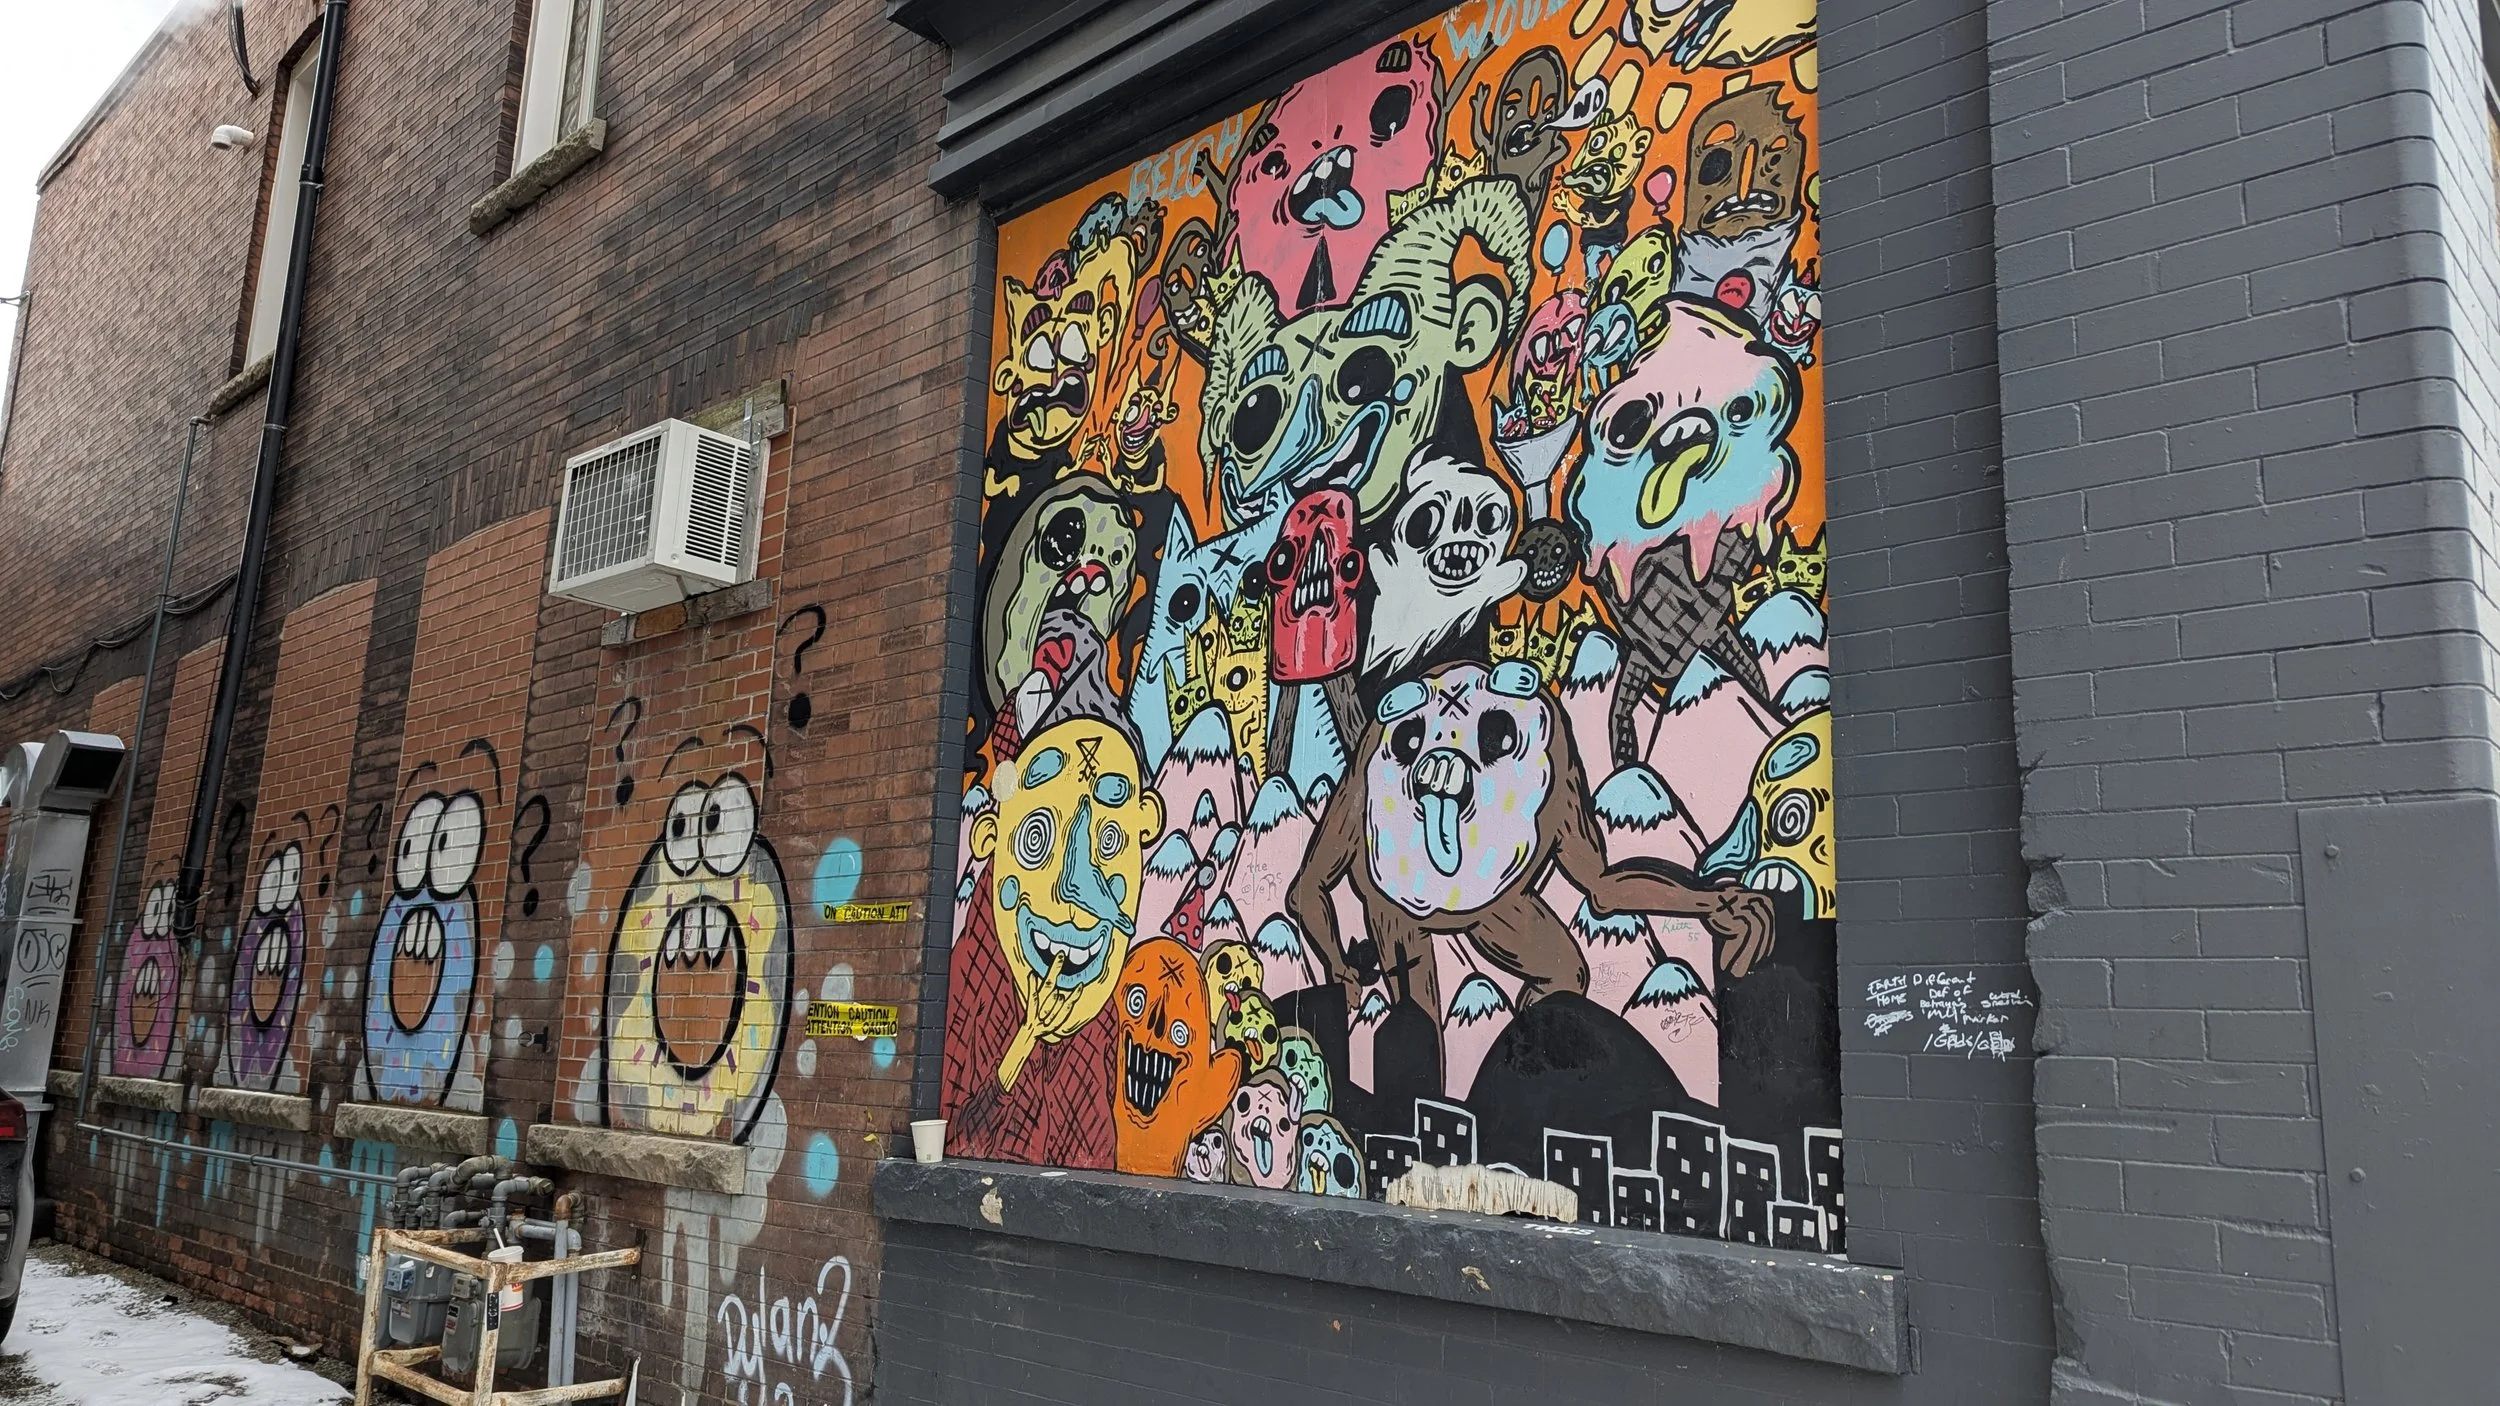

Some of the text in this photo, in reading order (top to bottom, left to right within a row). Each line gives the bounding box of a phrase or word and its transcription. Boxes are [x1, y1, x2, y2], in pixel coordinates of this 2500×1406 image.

[1573, 88, 1604, 120] NO
[1126, 113, 1244, 217] BEECH
[843, 905, 885, 920] CAUTION
[1867, 974, 1907, 996] EARTH
[1876, 992, 1907, 1007] HOME
[808, 1003, 889, 1022] ENTION CAUTION
[805, 1019, 853, 1034] ATTENTION
[1522, 1223, 1596, 1236] THIS
